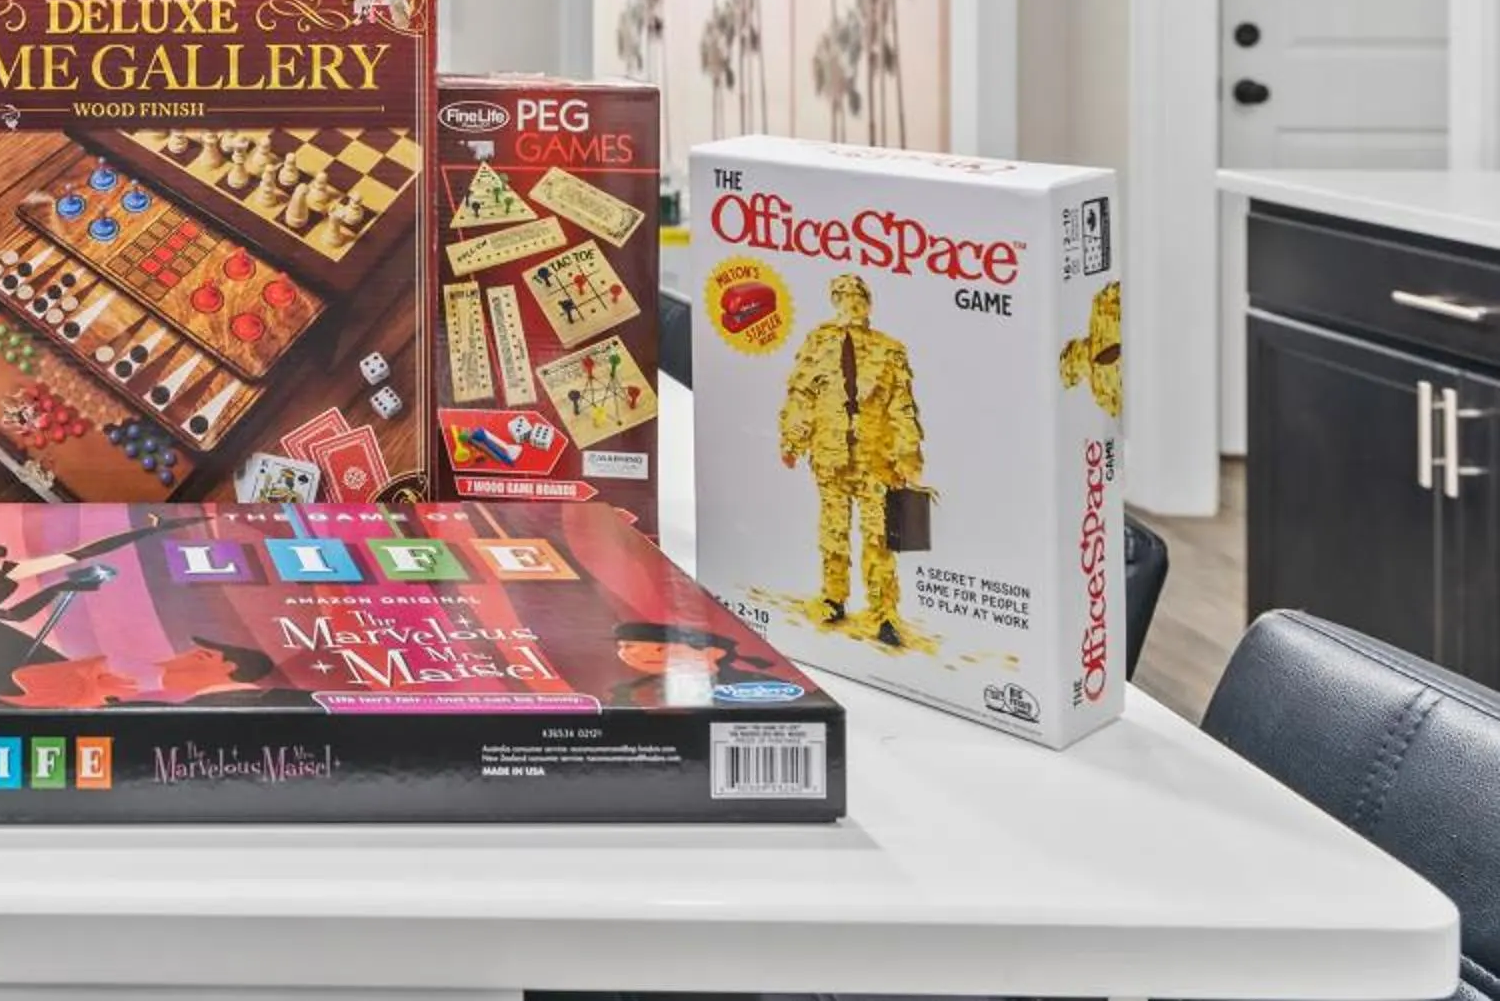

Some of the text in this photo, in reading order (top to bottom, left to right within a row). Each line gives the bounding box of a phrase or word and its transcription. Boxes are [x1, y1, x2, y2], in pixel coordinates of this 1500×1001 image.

[93, 44, 390, 91] GALLERY
[73, 102, 205, 118] WOOD FINISH
[517, 100, 589, 132] PEG
[515, 133, 632, 163] GAMES
[714, 169, 742, 191] THE
[955, 289, 1012, 317] GAME
[1105, 438, 1115, 482] GAME
[466, 479, 577, 497] 7 WOOD GAME BOARDS
[225, 513, 469, 522] THE GAME OF
[916, 567, 1030, 599] A SECRET MISSION
[916, 580, 1028, 615] GAME FOR PEOPLE
[285, 596, 480, 605] AMAZON ORIGINAL
[918, 595, 1029, 629] TO PLAY AT WORK
[276, 616, 539, 651] Marvelous
[348, 610, 396, 627] The
[332, 647, 560, 687] Maisel
[1073, 678, 1083, 710] THE
[153, 747, 260, 784] Marvelous
[262, 745, 331, 783] Maisel
[482, 767, 545, 776] MADE IN USA
